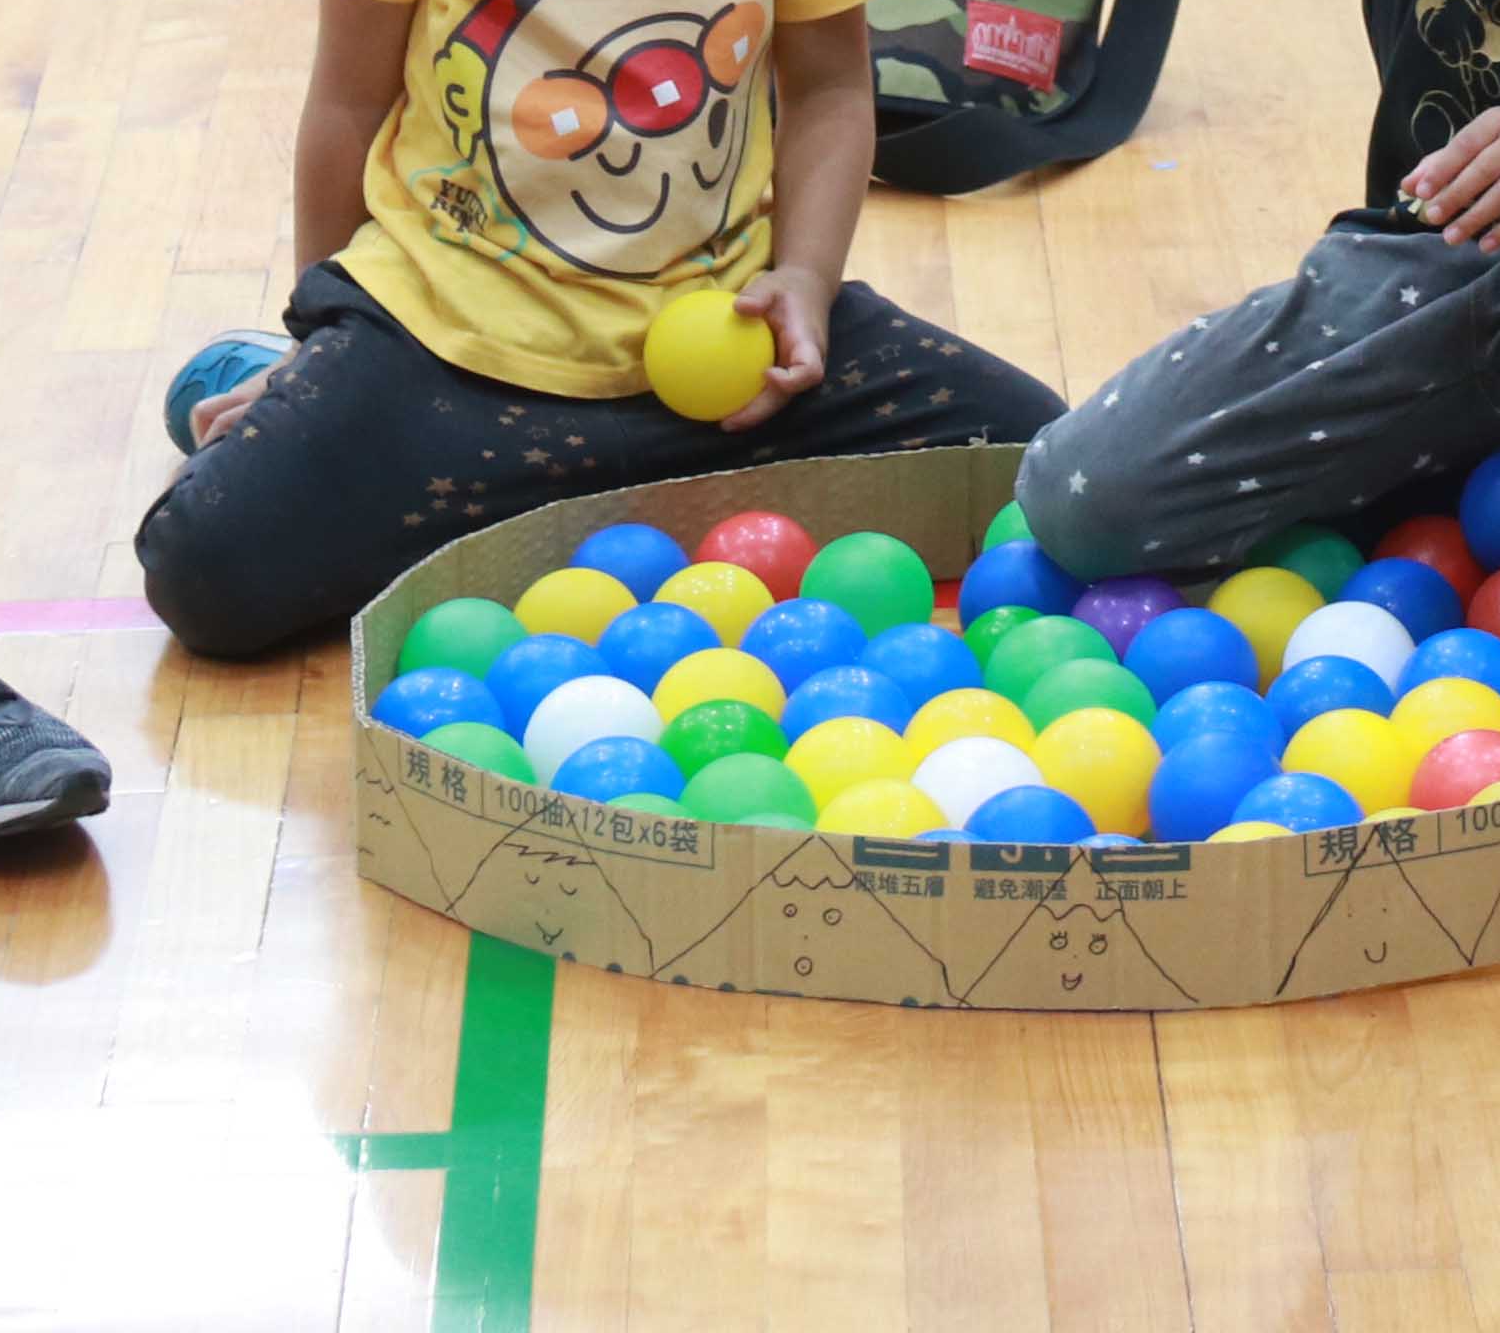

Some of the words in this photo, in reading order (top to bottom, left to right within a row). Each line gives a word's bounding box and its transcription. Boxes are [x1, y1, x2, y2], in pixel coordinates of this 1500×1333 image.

[406, 748, 469, 804] 規格
[1319, 818, 1418, 865] 規格
[1093, 877, 1188, 901] 正面朝上
